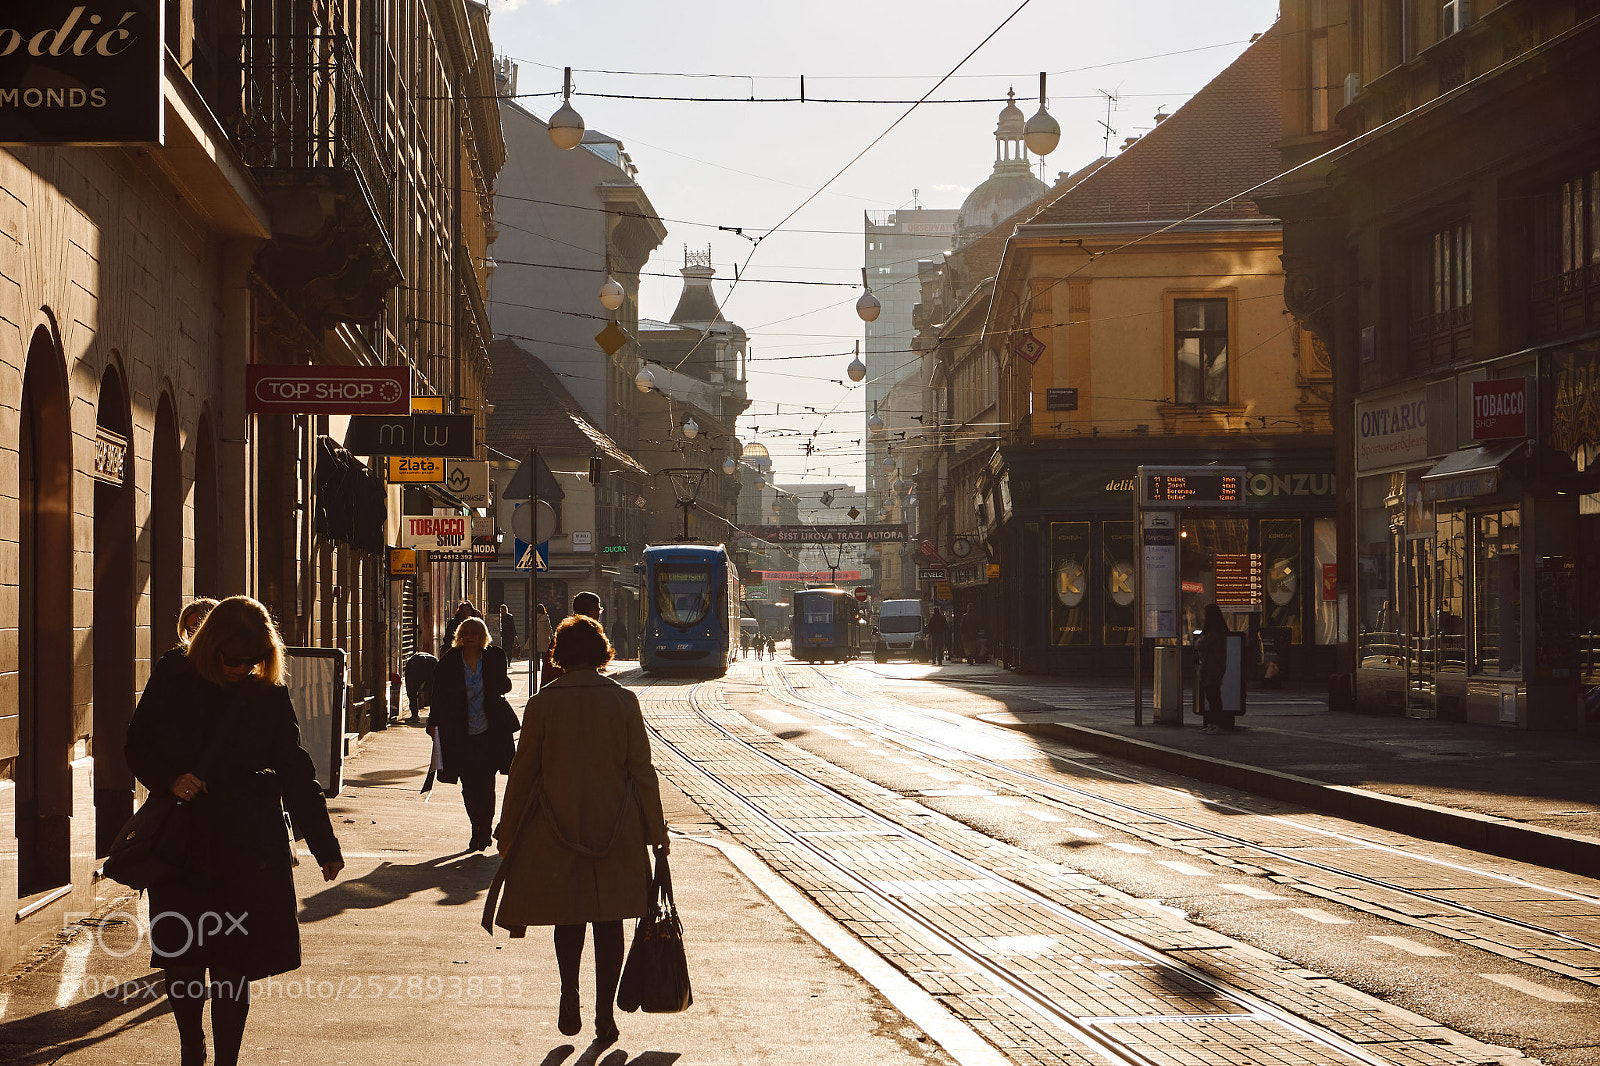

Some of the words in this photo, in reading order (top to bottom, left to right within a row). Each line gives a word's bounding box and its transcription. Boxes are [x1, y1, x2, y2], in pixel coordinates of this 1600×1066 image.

[0, 88, 107, 108] MONDS
[1027, 342, 1034, 352] 5
[269, 382, 310, 399] TOP
[315, 382, 374, 399] SHOP
[1475, 391, 1524, 417] TOBACCO
[1475, 418, 1496, 428] SHOP
[398, 458, 435, 471] Zlata
[409, 518, 465, 536] TOBACCO
[437, 534, 465, 546] SHOP
[778, 531, 799, 541] ŠEST
[801, 532, 833, 541] LIKOVA
[837, 531, 864, 540] TRAŽI
[867, 531, 904, 540] AUTORA
[472, 544, 496, 553] MODA
